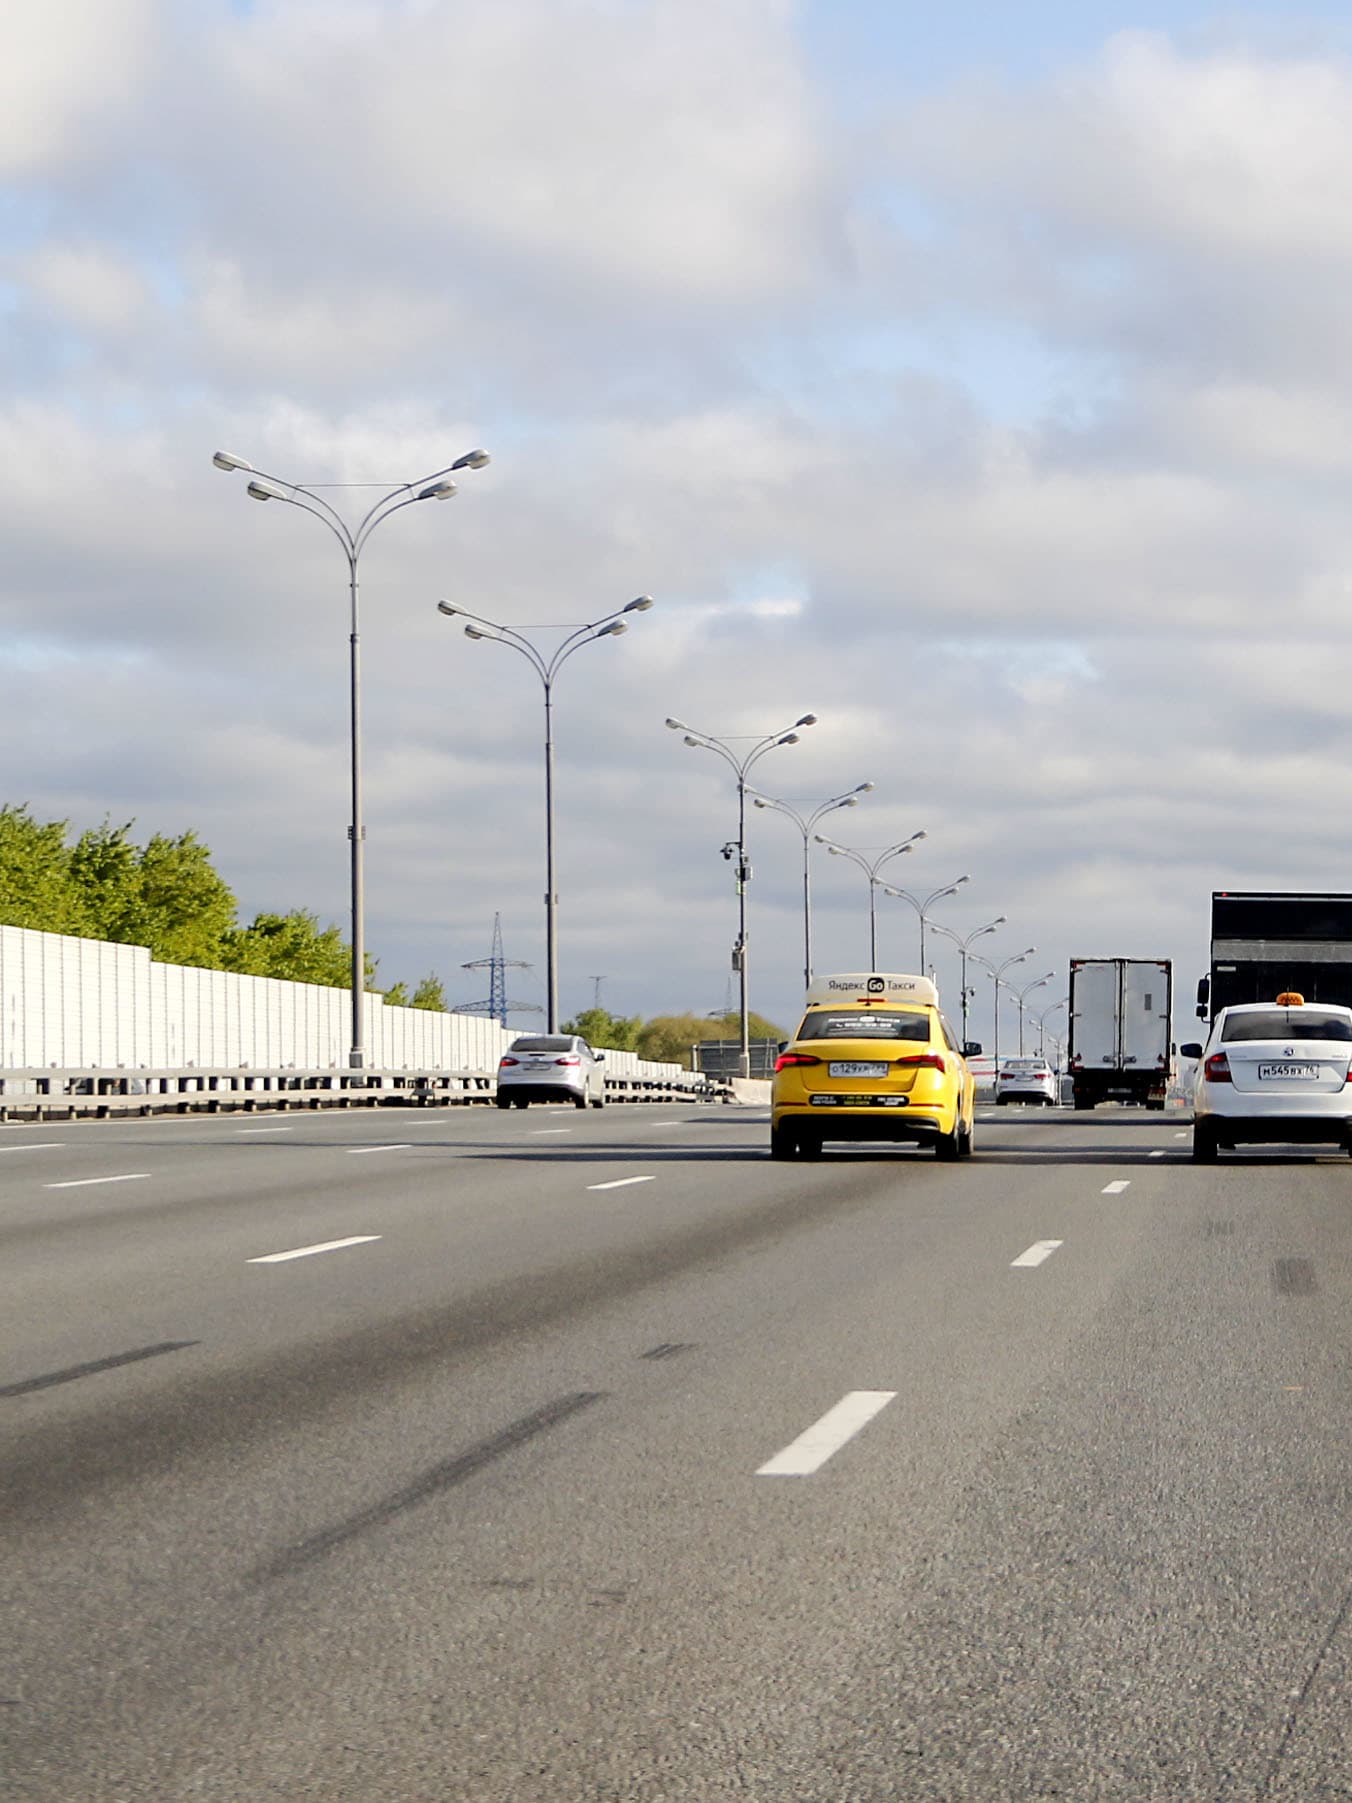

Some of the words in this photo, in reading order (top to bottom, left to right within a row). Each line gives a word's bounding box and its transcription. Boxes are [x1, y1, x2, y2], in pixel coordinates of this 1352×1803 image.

[828, 980, 865, 991] Яндекс
[868, 979, 885, 991] Go
[887, 980, 916, 990] Такси
